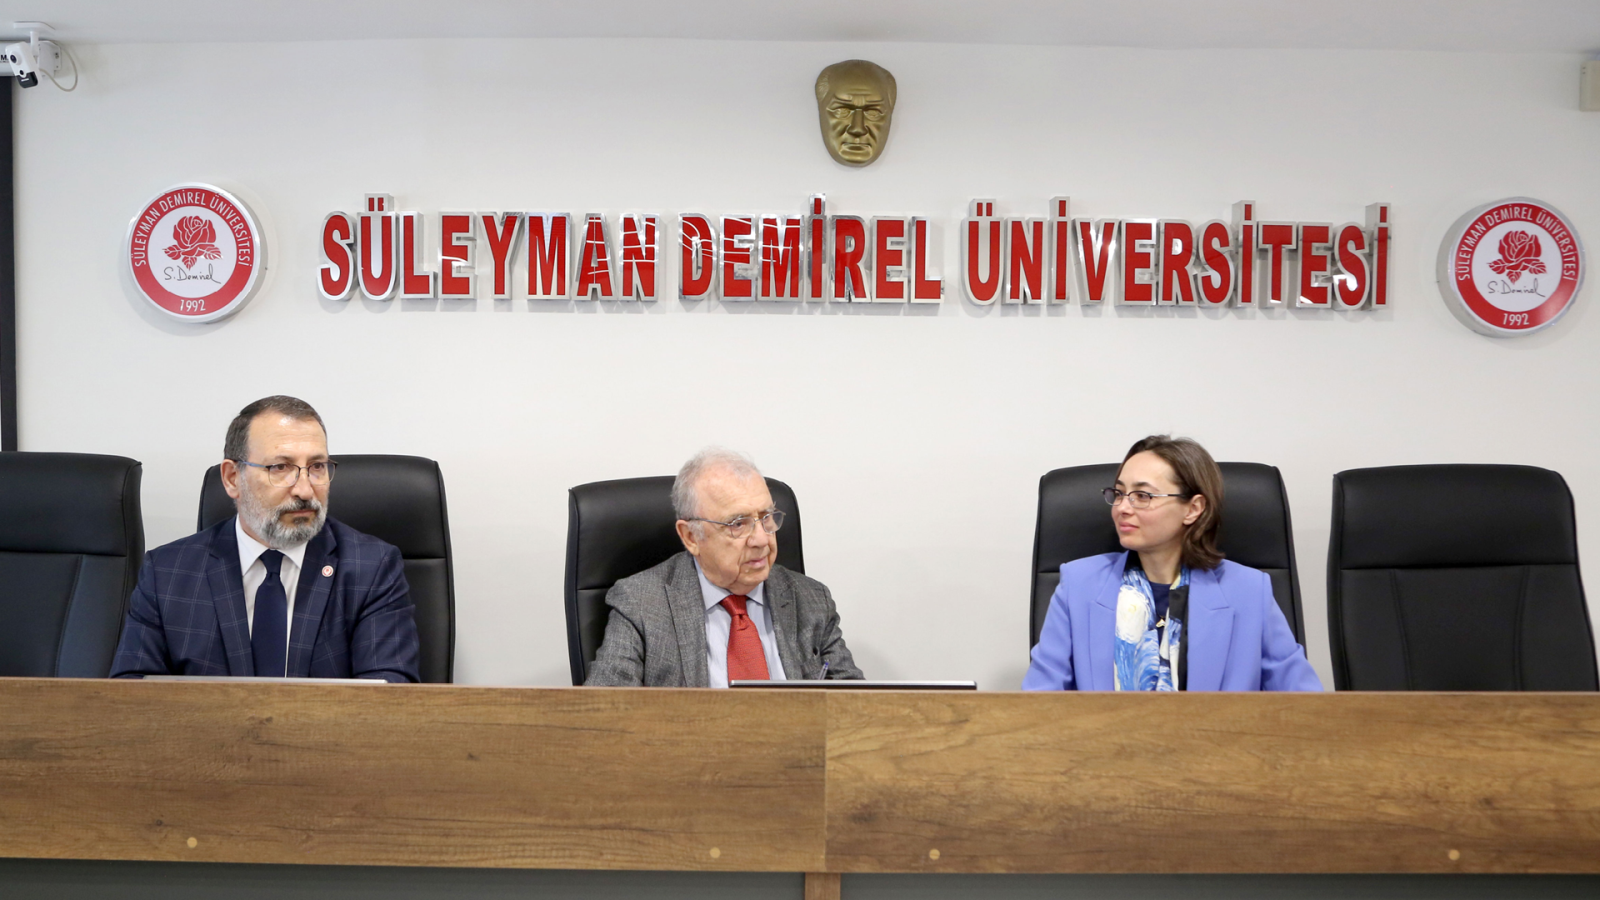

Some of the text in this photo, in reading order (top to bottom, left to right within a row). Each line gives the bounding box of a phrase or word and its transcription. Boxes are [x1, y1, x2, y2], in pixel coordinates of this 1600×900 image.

[131, 189, 253, 267] SÜLEYMAN DEMİREL ÜNİVERSİTESİ
[317, 192, 1393, 310] SÜLEYMAN DEMİREL ÜNİVERSİTESİ
[1455, 204, 1578, 281] SÜLEYMAN DEMİREL ÜNİVERSİTESİ
[179, 299, 206, 312] 1992
[1502, 313, 1530, 326] 1992
